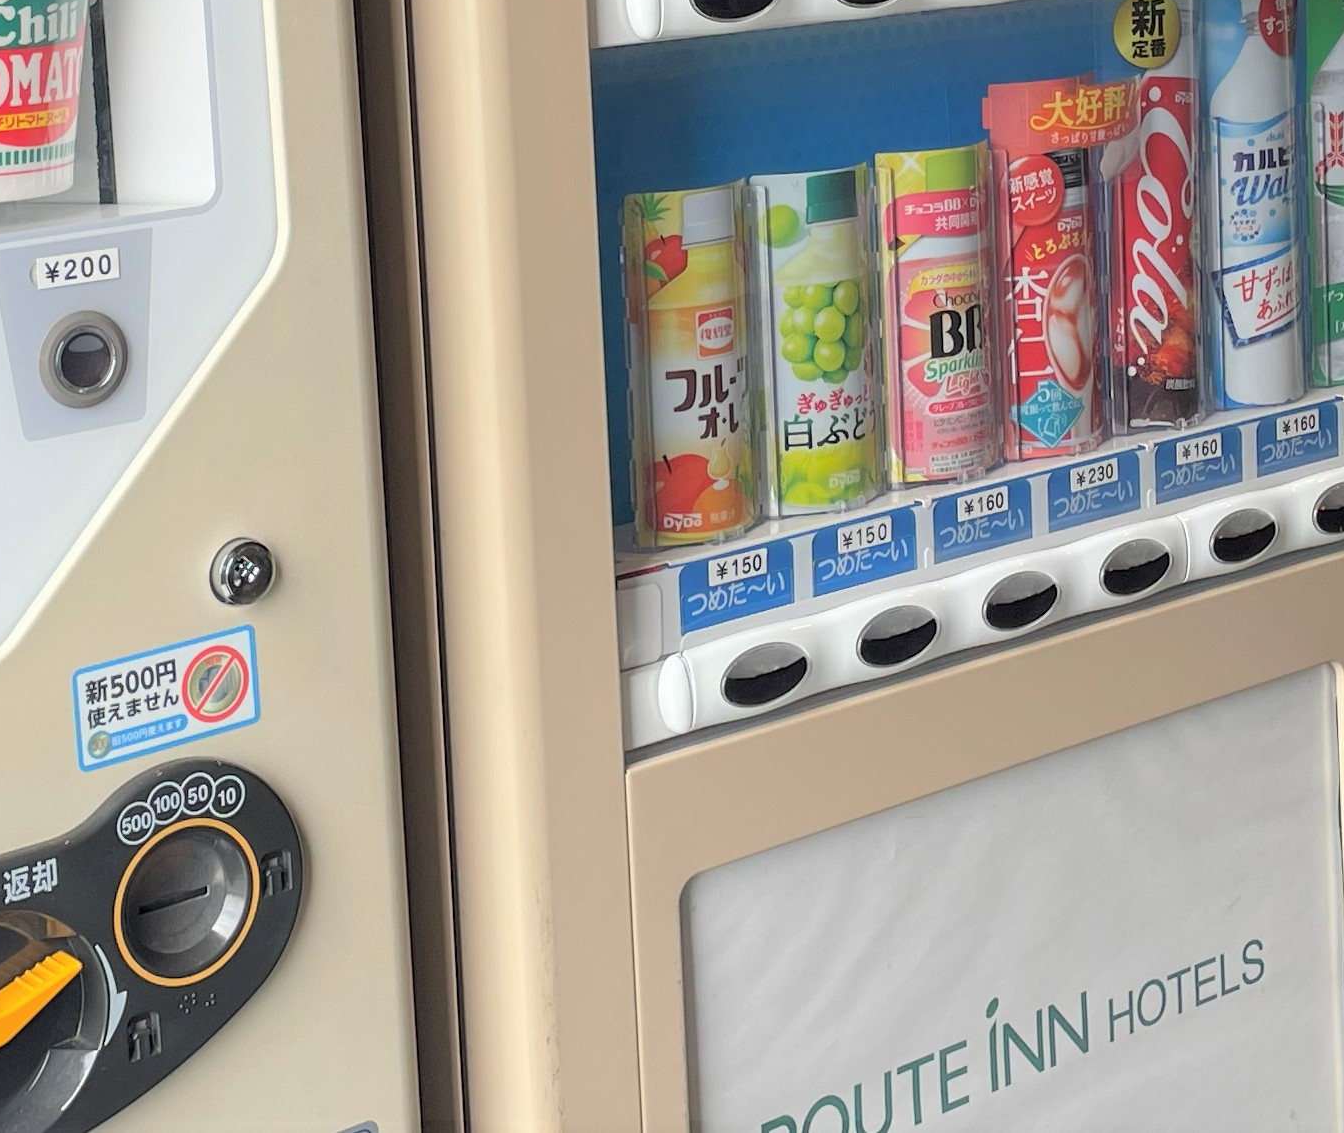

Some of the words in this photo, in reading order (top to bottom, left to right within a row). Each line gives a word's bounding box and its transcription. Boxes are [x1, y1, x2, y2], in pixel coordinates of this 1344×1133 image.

[1131, 39, 1166, 60] 定番
[1008, 167, 1054, 195] 新感覚
[1010, 187, 1057, 214] スイーツ
[1129, 106, 1195, 355] Cola
[44, 254, 112, 283] ¥200
[1283, 414, 1316, 435] ¥160
[1181, 438, 1218, 460] ¥160
[828, 469, 861, 489] DyDo
[1076, 465, 1114, 487] ¥230
[963, 492, 1004, 515] ¥160
[662, 511, 703, 533] DyDo
[842, 523, 888, 547] ¥150
[715, 555, 763, 579] ¥150
[85, 659, 177, 705] 新500円
[88, 689, 179, 730] 使えません
[121, 809, 152, 835] 500
[153, 789, 181, 815] 100
[187, 783, 209, 804] 50
[217, 787, 237, 807] 10
[1107, 938, 1266, 1044] HOTELS
